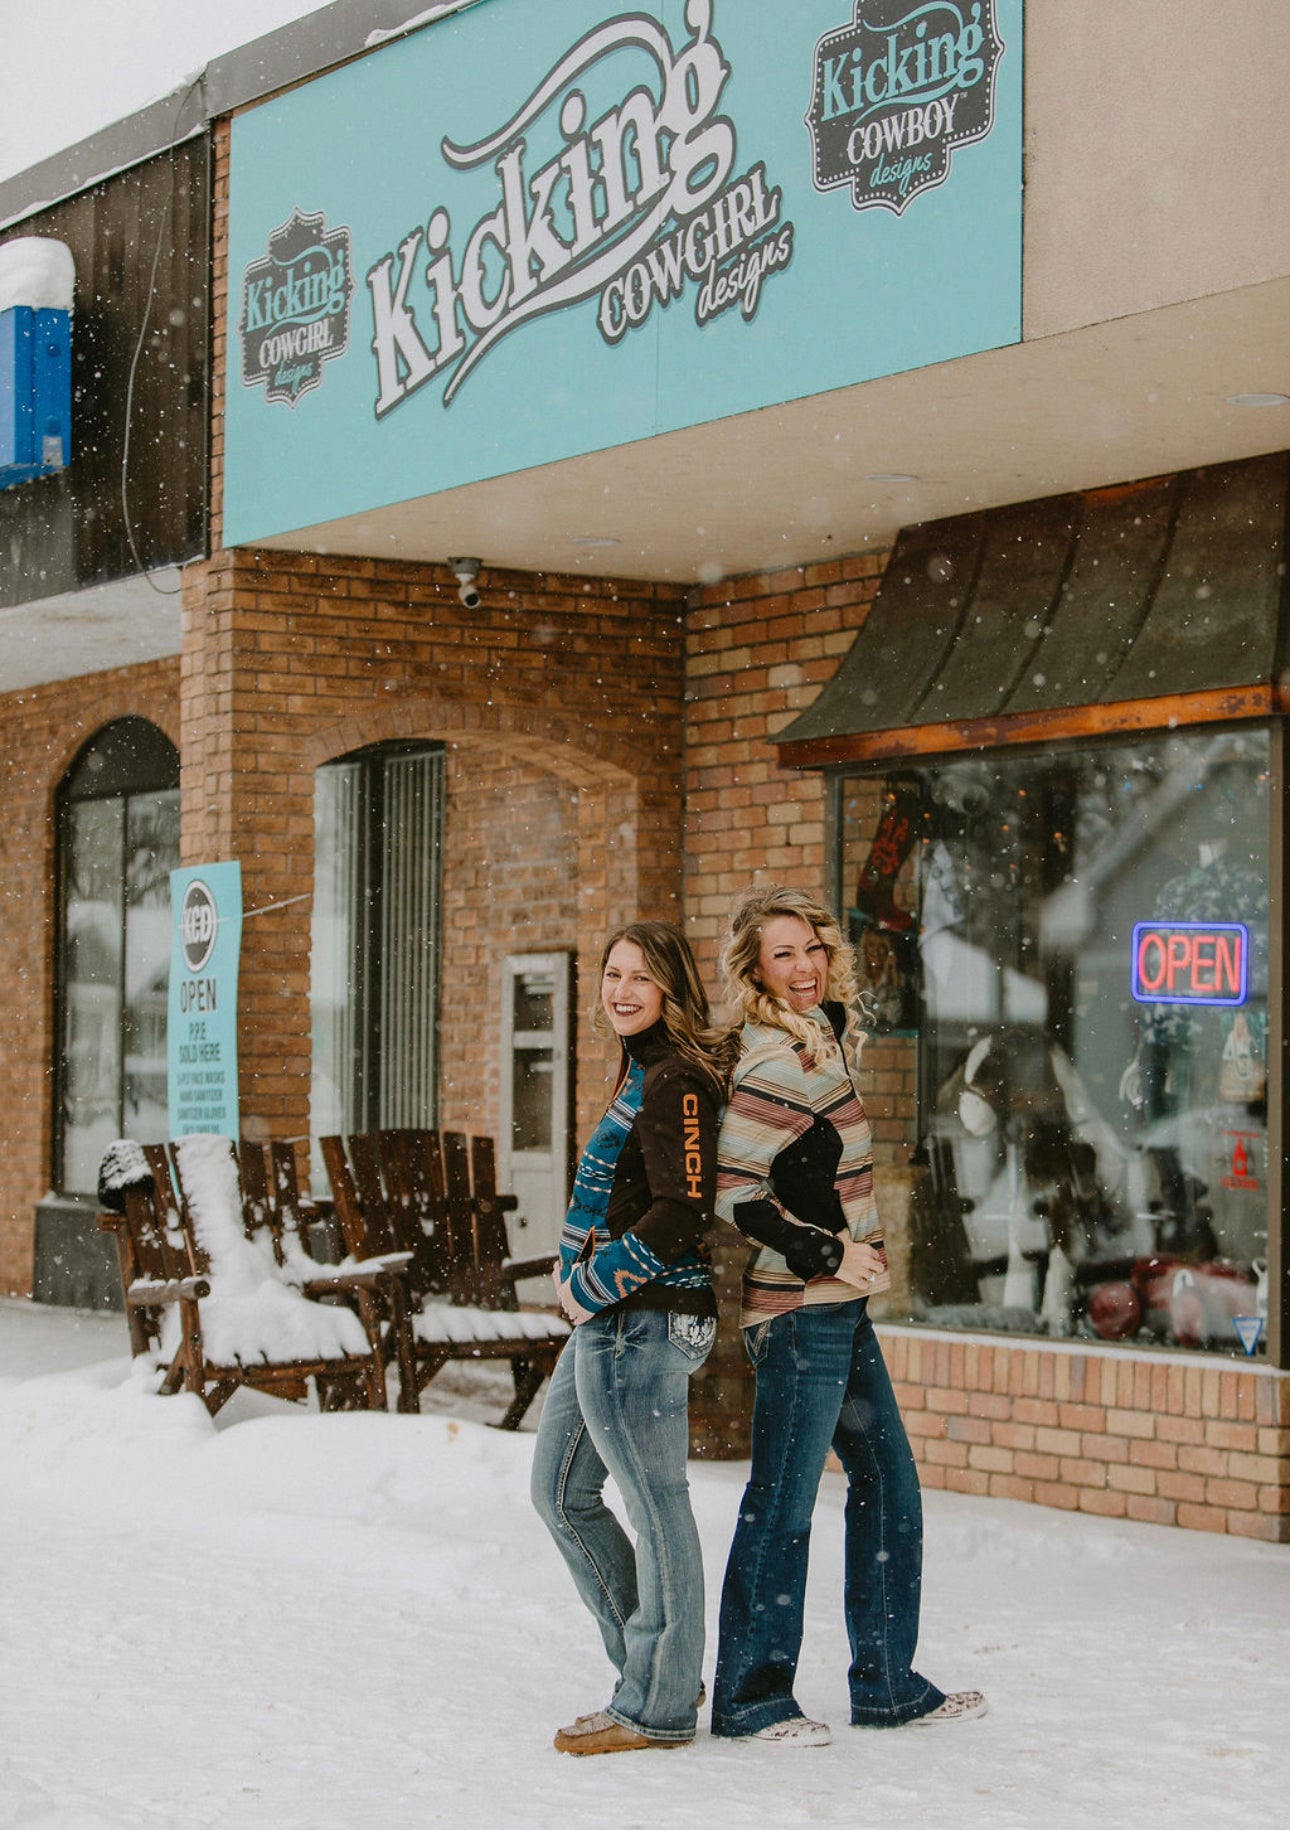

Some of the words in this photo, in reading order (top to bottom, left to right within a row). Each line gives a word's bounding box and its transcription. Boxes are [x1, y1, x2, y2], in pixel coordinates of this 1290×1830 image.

[821, 1, 985, 124] Kicking
[847, 93, 958, 165] COWBOY
[366, 0, 735, 416] Kicking
[870, 152, 933, 195] designs
[599, 165, 781, 341] COWGIRL
[696, 225, 792, 323] designs
[246, 246, 346, 335] Kicking
[259, 320, 334, 369] COWGIRL
[274, 361, 313, 394] designs
[180, 977, 217, 1014] OPEN
[1138, 932, 1241, 994] OPEN
[199, 1042, 221, 1062] HERE
[681, 1092, 703, 1199] CINCH
